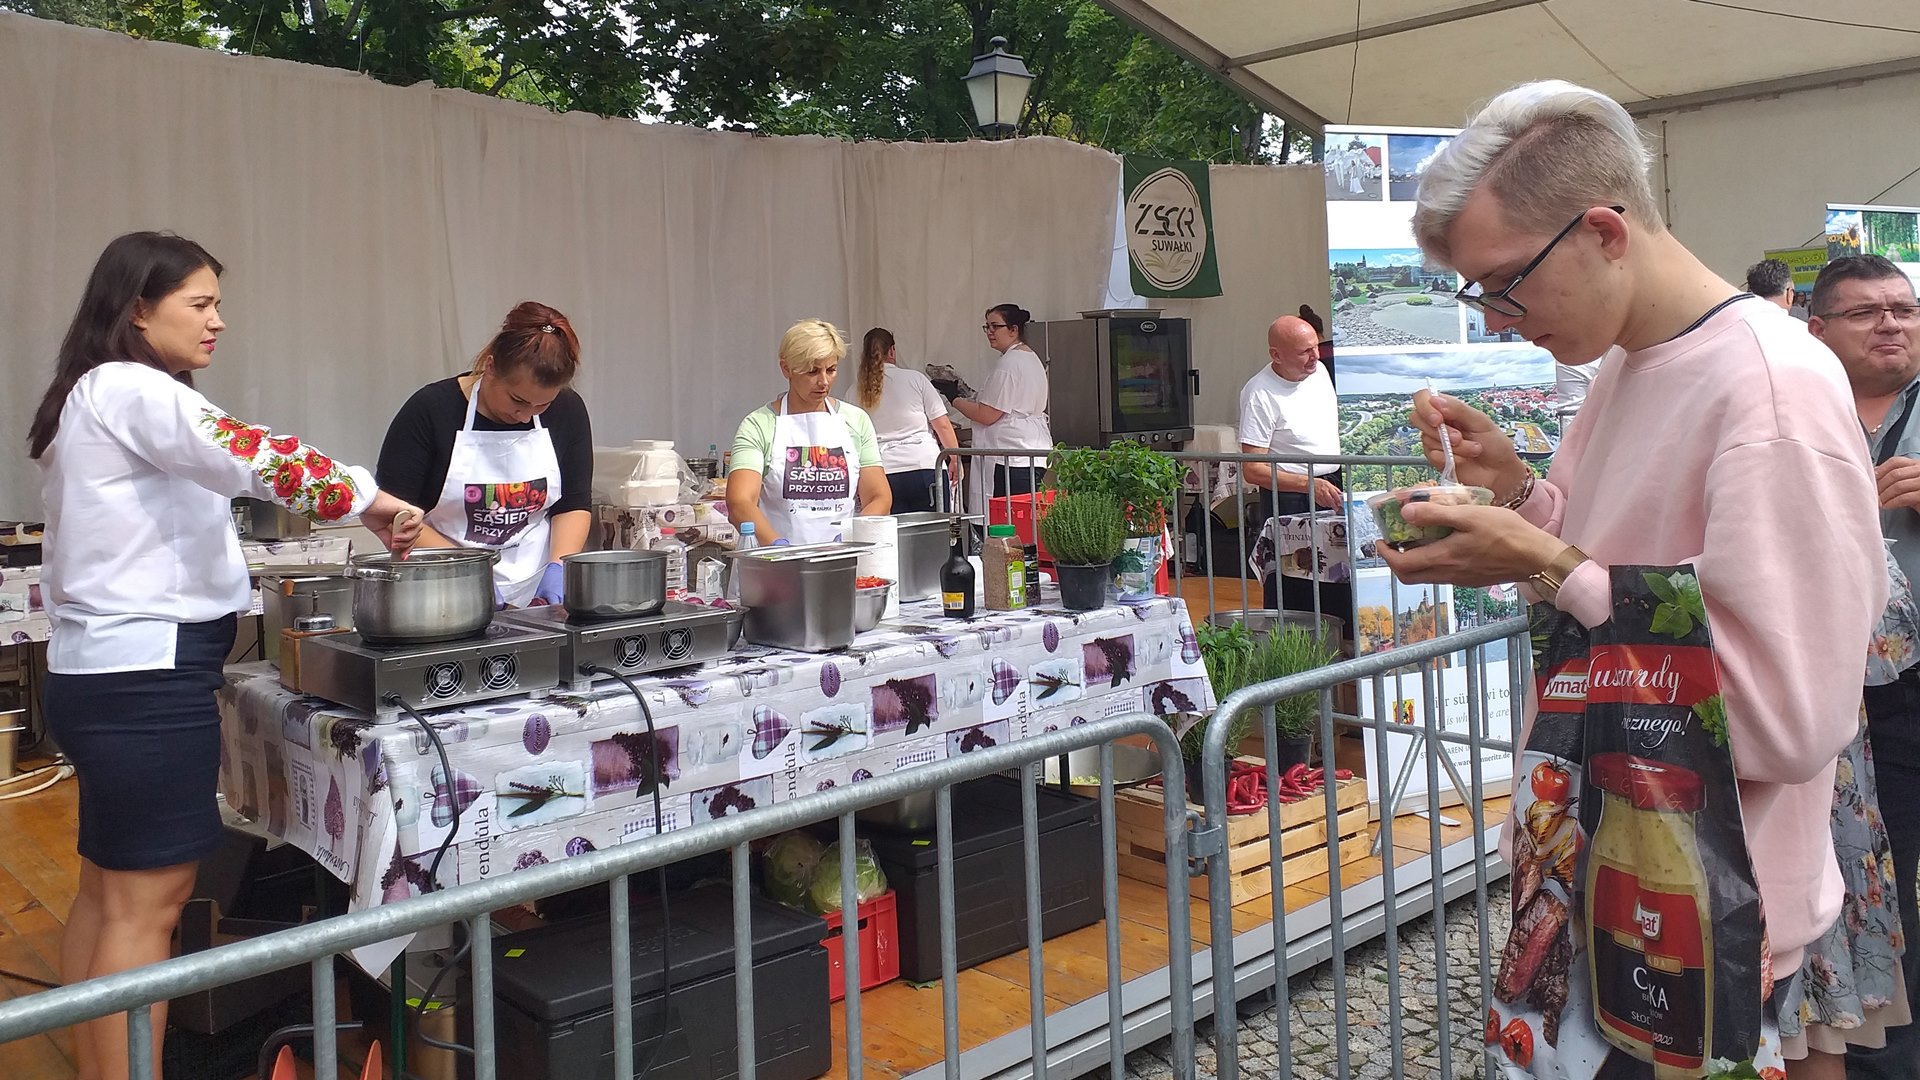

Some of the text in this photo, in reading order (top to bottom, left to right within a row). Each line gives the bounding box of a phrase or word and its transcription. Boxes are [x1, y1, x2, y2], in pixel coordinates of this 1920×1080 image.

[1152, 240, 1192, 252] SUWAŁKI
[789, 470, 845, 483] SĄSIEDZI
[788, 484, 845, 493] PRZY STOLE
[473, 511, 528, 526] SĄSIED
[473, 525, 504, 538] PRZY
[1499, 687, 1510, 699] to
[1495, 708, 1510, 718] are
